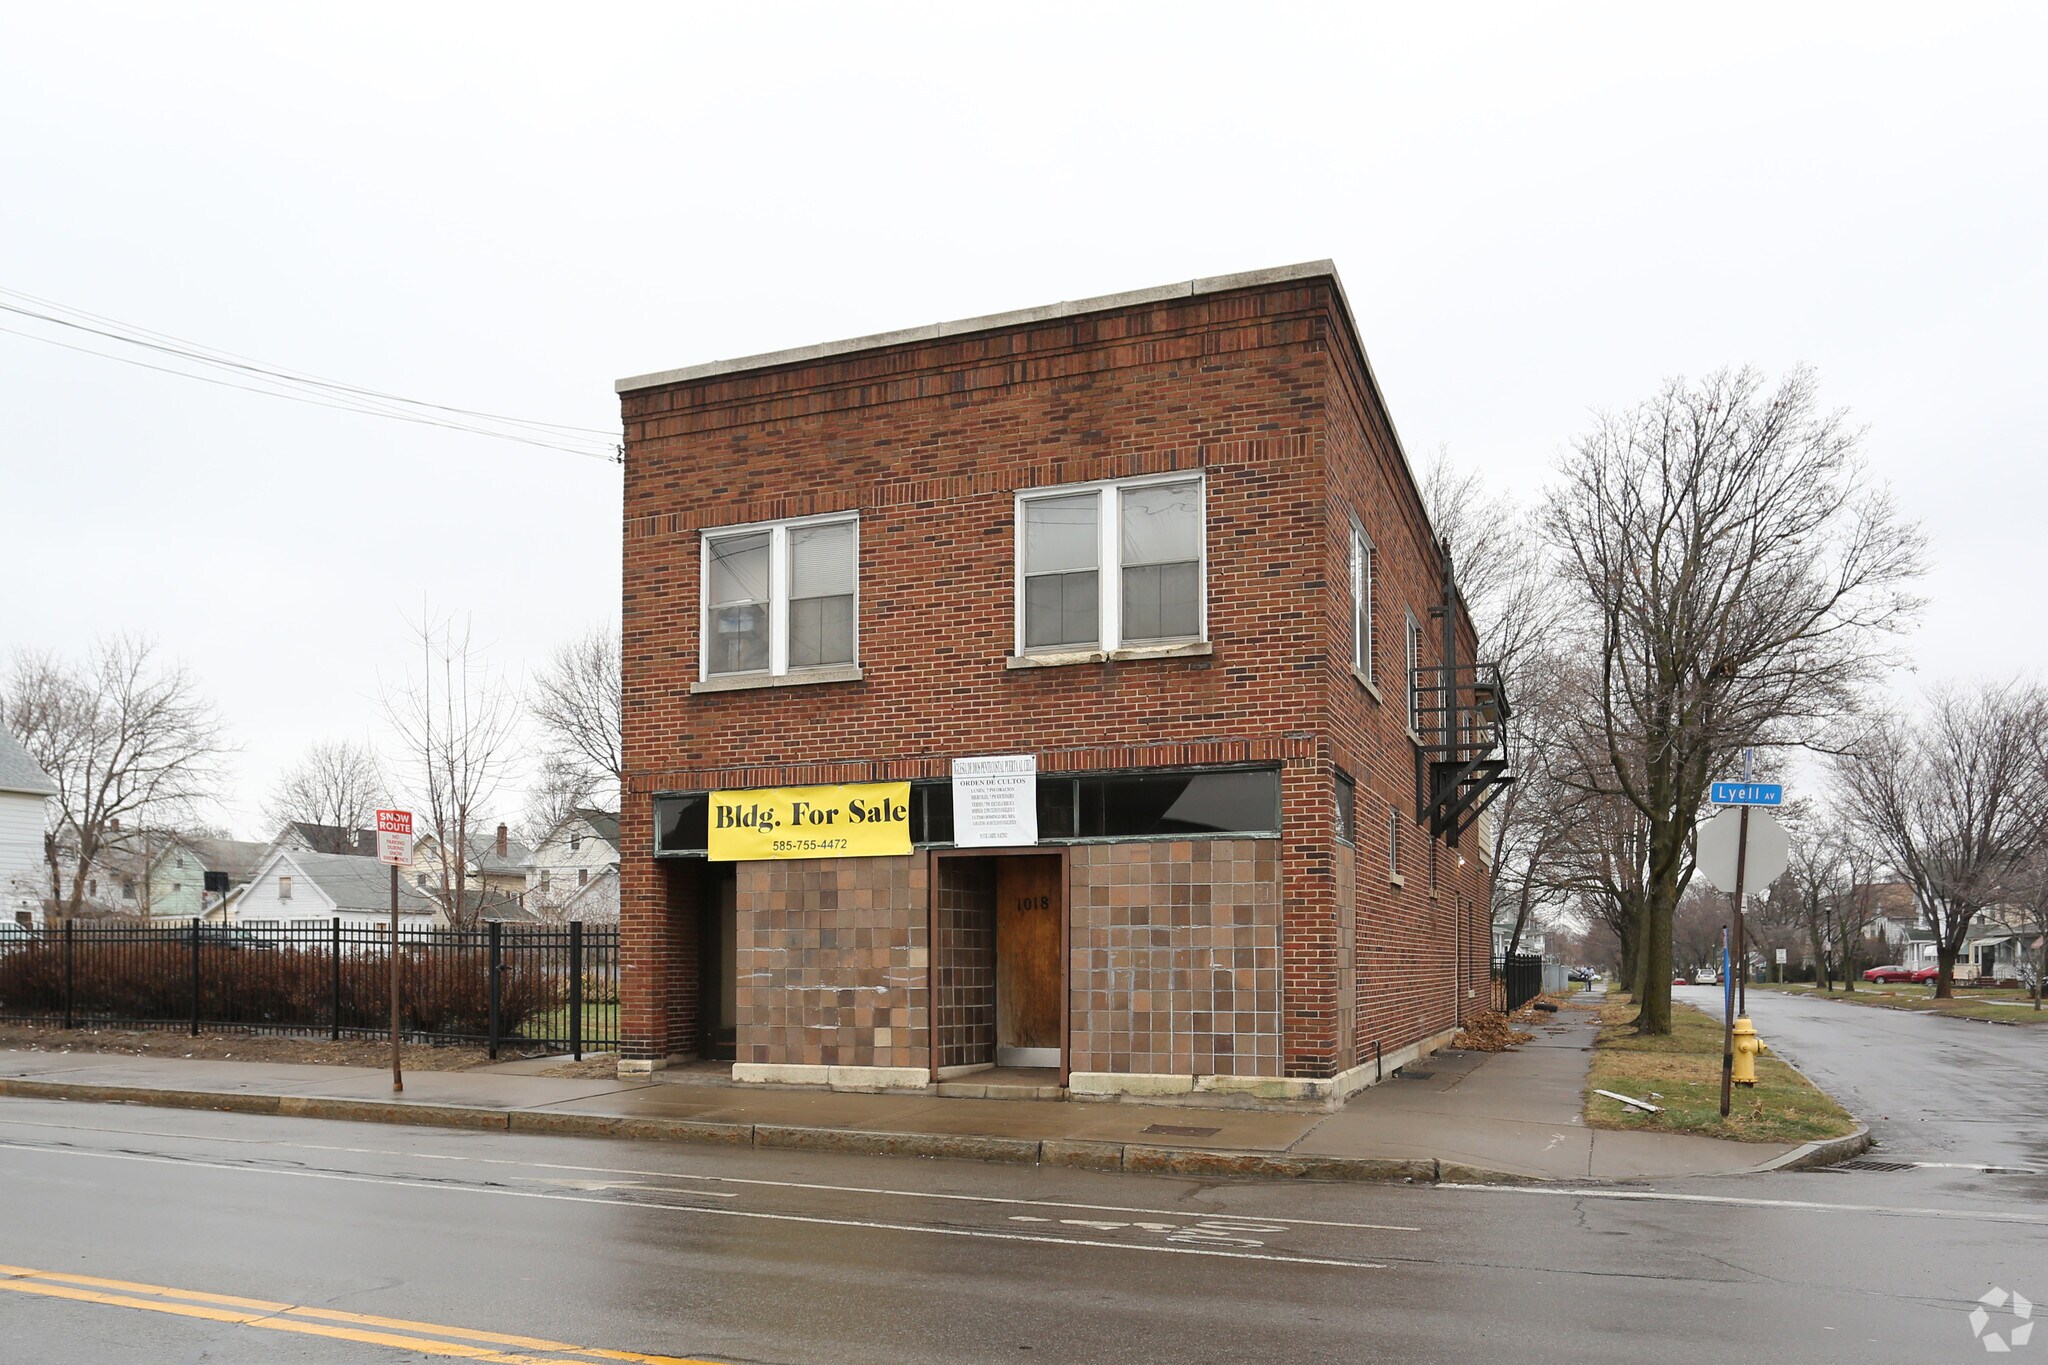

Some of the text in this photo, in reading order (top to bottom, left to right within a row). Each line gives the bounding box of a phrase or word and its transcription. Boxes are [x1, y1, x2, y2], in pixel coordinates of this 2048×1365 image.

[1718, 786, 1775, 802] Lyell AV
[380, 813, 409, 823] SNOW
[715, 797, 908, 834] Bldg. For Sale
[380, 821, 410, 832] ROUTE
[772, 838, 848, 851] 585-755-4472
[1017, 897, 1049, 911] 1018
